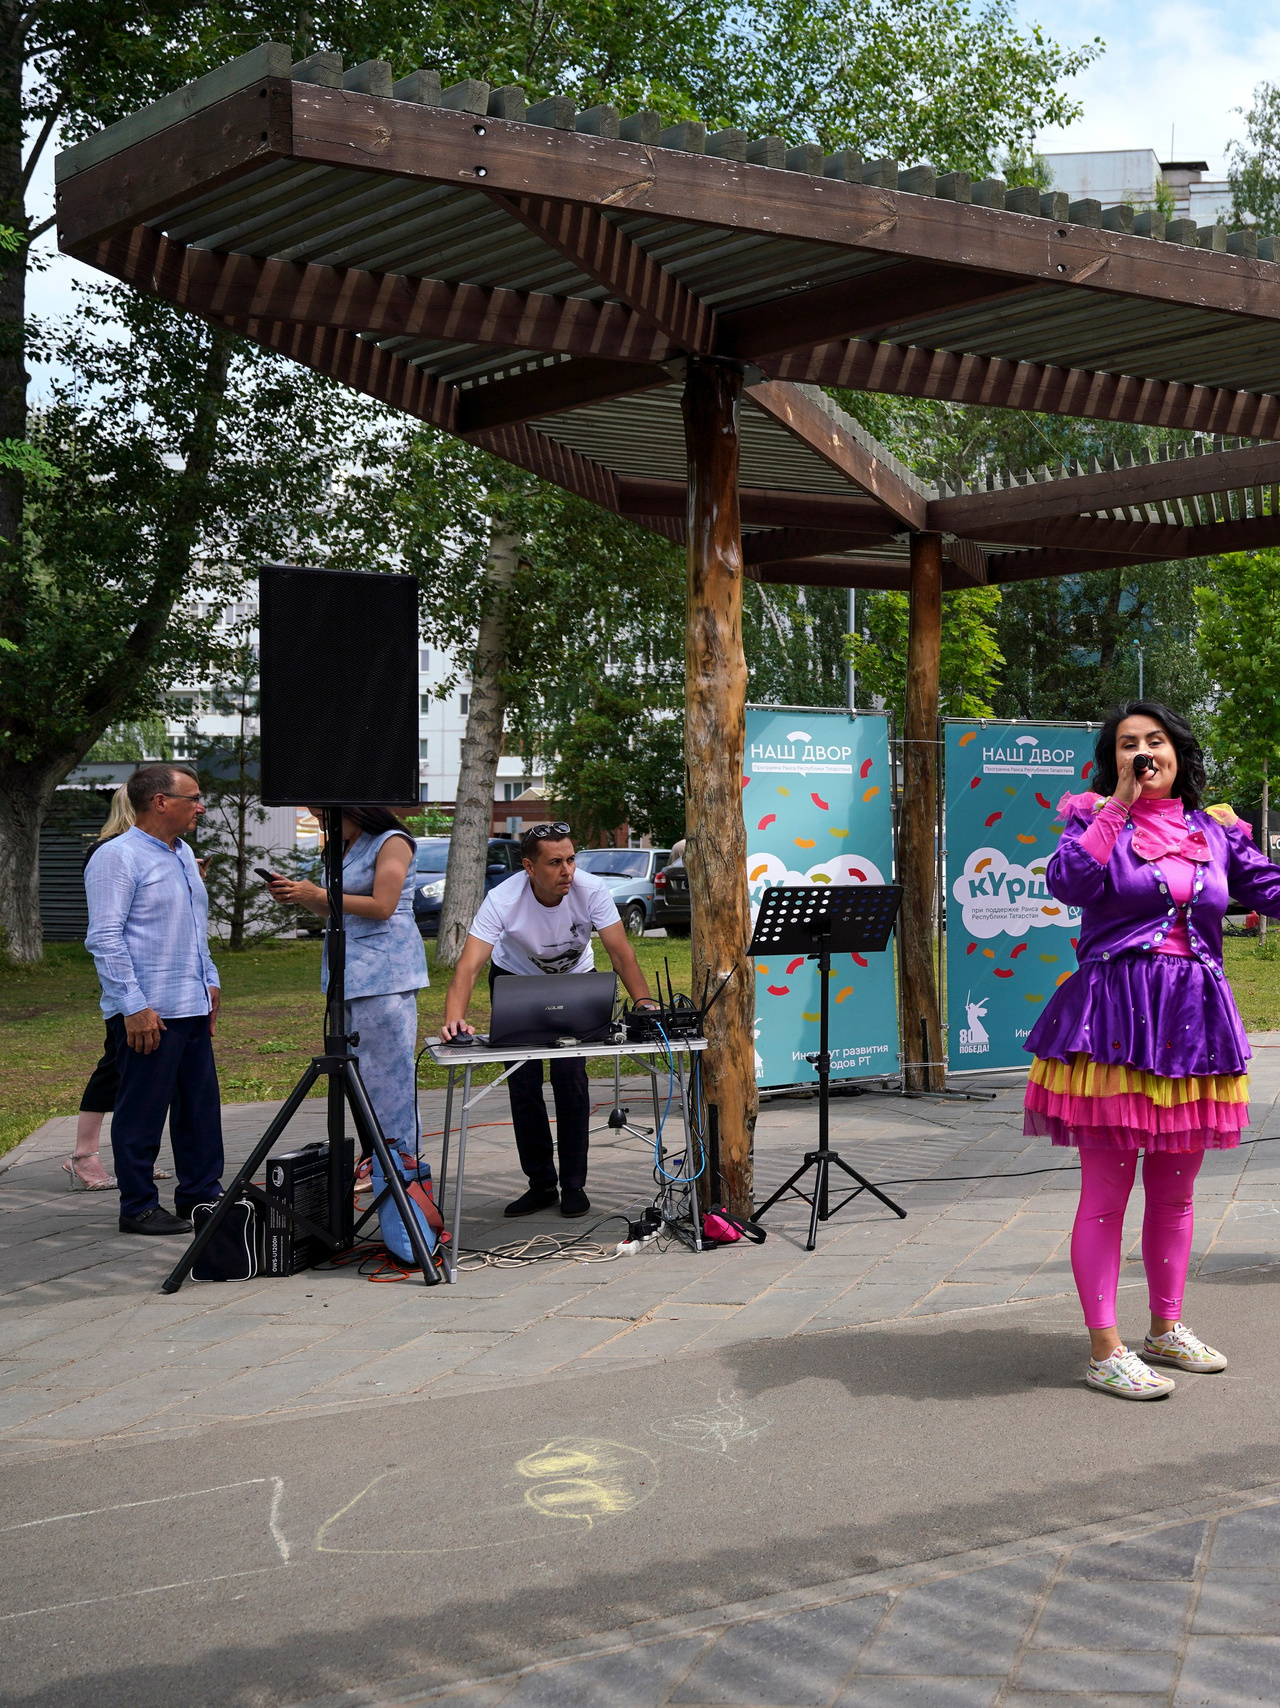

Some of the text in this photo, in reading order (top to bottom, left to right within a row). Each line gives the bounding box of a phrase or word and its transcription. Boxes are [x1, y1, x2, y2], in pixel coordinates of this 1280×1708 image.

[750, 743, 852, 762] НАШ ДВОР
[982, 747, 1075, 764] НАШ ДВОР
[753, 764, 782, 772] Программа
[797, 765, 825, 773] Республики
[959, 1028, 974, 1044] 80
[792, 1044, 889, 1062] Инстут развития
[959, 1044, 990, 1054] ПОБЕДА!
[811, 1055, 872, 1071] годов РТ
